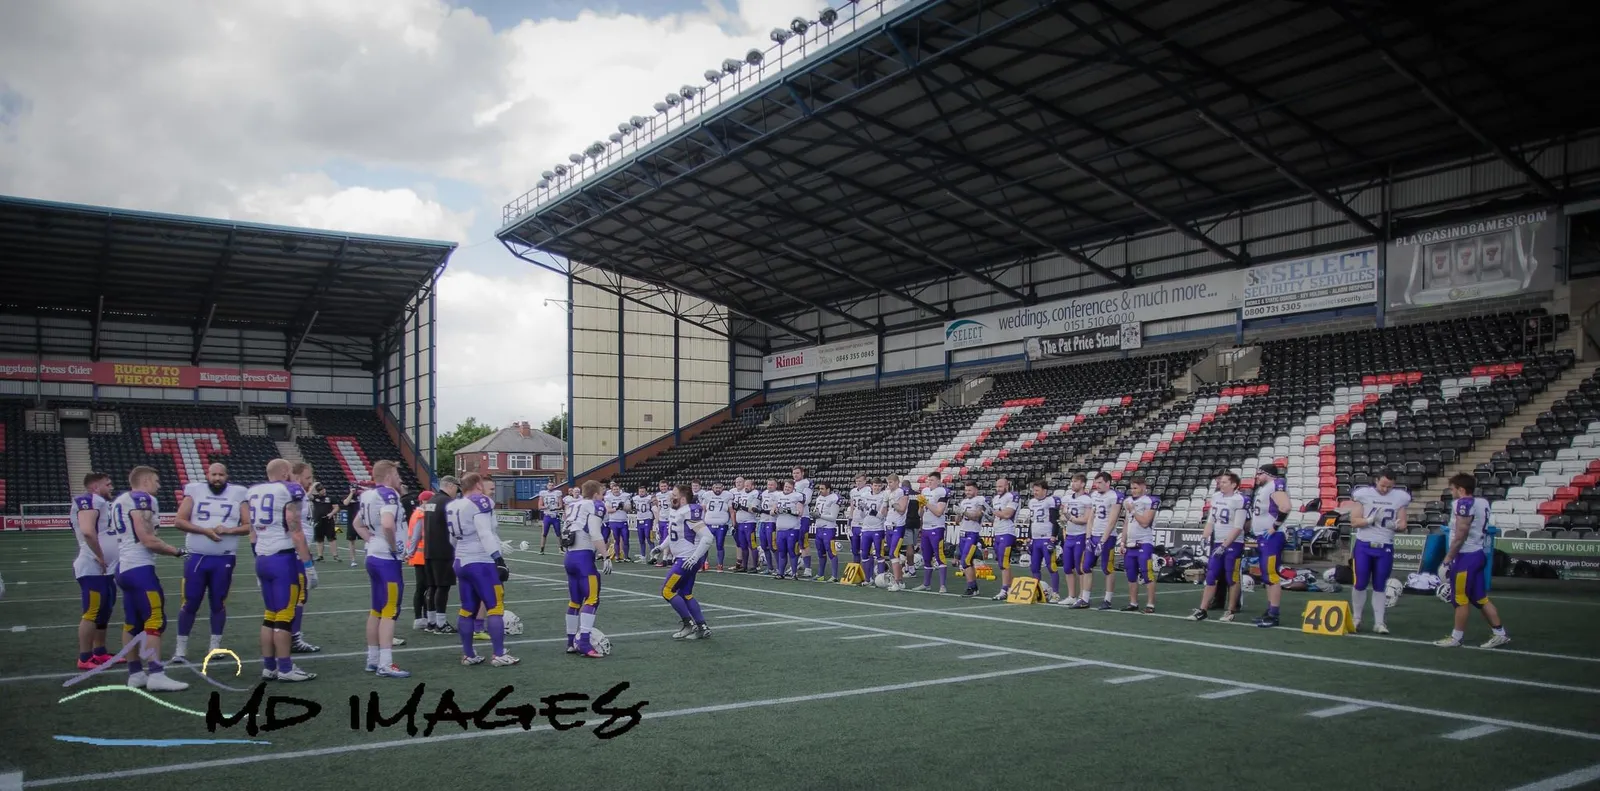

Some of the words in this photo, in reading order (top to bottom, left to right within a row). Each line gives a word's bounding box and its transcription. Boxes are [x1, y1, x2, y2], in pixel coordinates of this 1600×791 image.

[1395, 211, 1548, 248] PLAYCASINOGAMES.COM
[1271, 249, 1376, 284] SELECT
[1244, 280, 1308, 299] SECURITY
[1310, 268, 1376, 290] SERVICES
[998, 309, 1050, 330] weddings,
[1052, 298, 1118, 323] conferences
[1120, 291, 1131, 311] &
[1133, 285, 1168, 309] much
[1172, 283, 1218, 301] more...
[1244, 306, 1265, 317] 0800
[1266, 304, 1279, 314] 731
[1281, 302, 1302, 313] 5305
[1064, 319, 1085, 332] 0151
[1088, 316, 1105, 328] 510
[1107, 311, 1135, 325] 6000
[953, 326, 984, 342] SELECT
[1042, 339, 1057, 355] The
[1058, 337, 1072, 354] Pat
[1073, 335, 1095, 351] Price
[1096, 330, 1121, 347] Stand
[775, 352, 804, 369] Rinnai
[850, 351, 860, 361] 355
[40, 364, 66, 374] Press
[68, 365, 93, 375] Cider
[114, 364, 158, 375] RUGBY
[161, 366, 180, 377] TO
[200, 372, 241, 383] Kingstone
[243, 373, 265, 382] Press
[266, 374, 288, 383] Cider
[115, 375, 143, 385] THE
[144, 375, 180, 386] CORE
[197, 501, 233, 523] 57
[708, 500, 724, 512] 67
[1153, 530, 1175, 548] EL
[1511, 542, 1524, 551] WE
[1525, 542, 1547, 551] NEED
[1548, 543, 1565, 552] YOU
[1566, 543, 1575, 552] IN
[1576, 544, 1595, 553] OUR
[1562, 560, 1580, 568] Organ
[842, 565, 857, 583] 40
[1010, 580, 1035, 600] 45
[1304, 605, 1344, 633] 40
